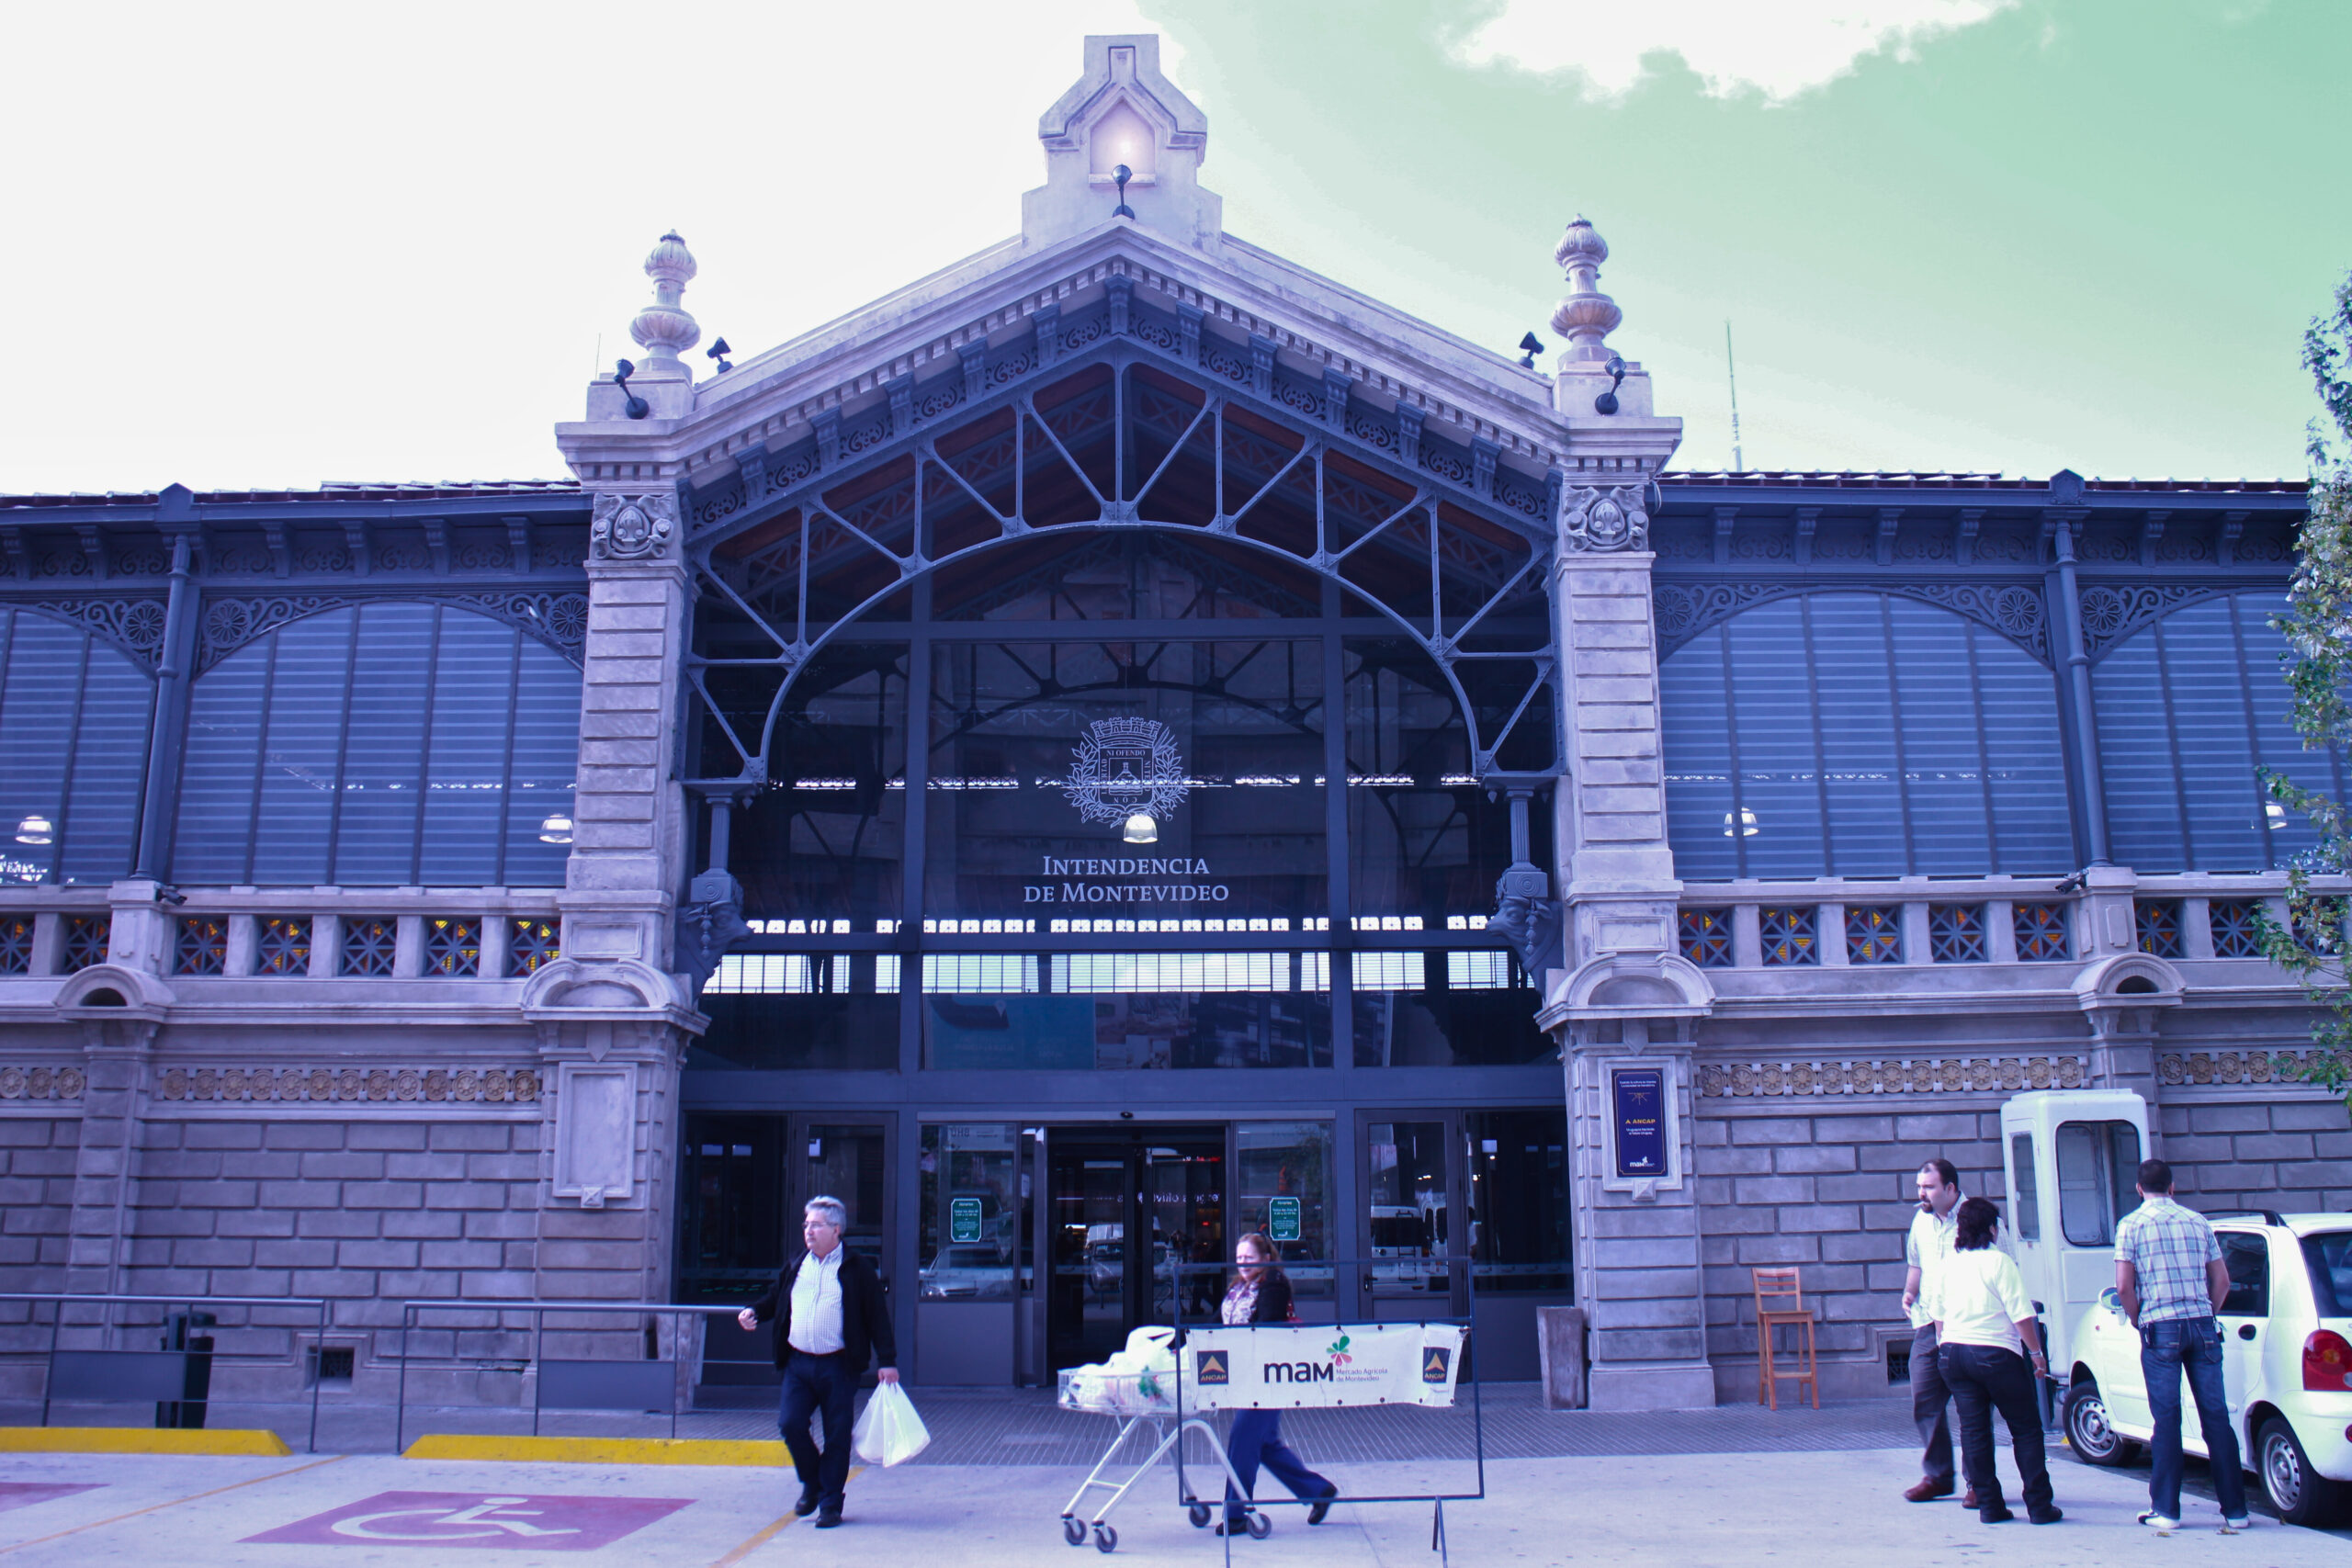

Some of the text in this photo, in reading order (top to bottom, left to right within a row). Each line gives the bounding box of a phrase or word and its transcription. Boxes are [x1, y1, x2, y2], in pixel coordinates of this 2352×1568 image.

[1043, 856, 1210, 875] INTENDENCIA
[1023, 883, 1229, 902] DE MONTEVIDEO
